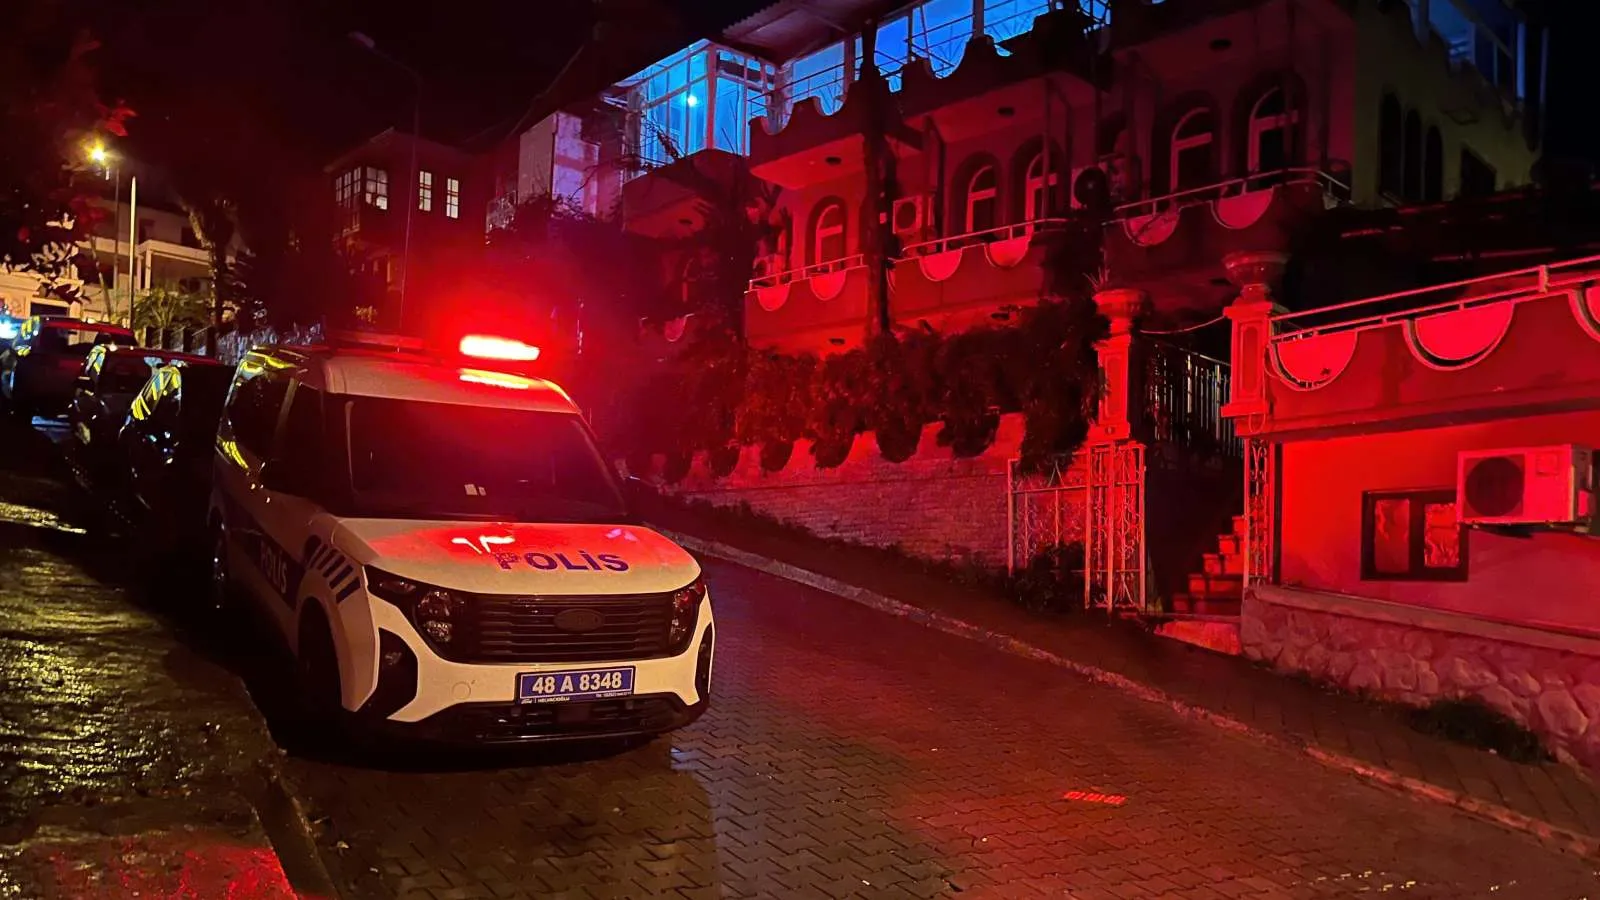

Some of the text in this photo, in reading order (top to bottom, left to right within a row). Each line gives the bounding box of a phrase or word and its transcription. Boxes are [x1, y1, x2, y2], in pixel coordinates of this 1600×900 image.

[495, 550, 629, 571] POLİS
[532, 672, 622, 694] 48 A 8348
